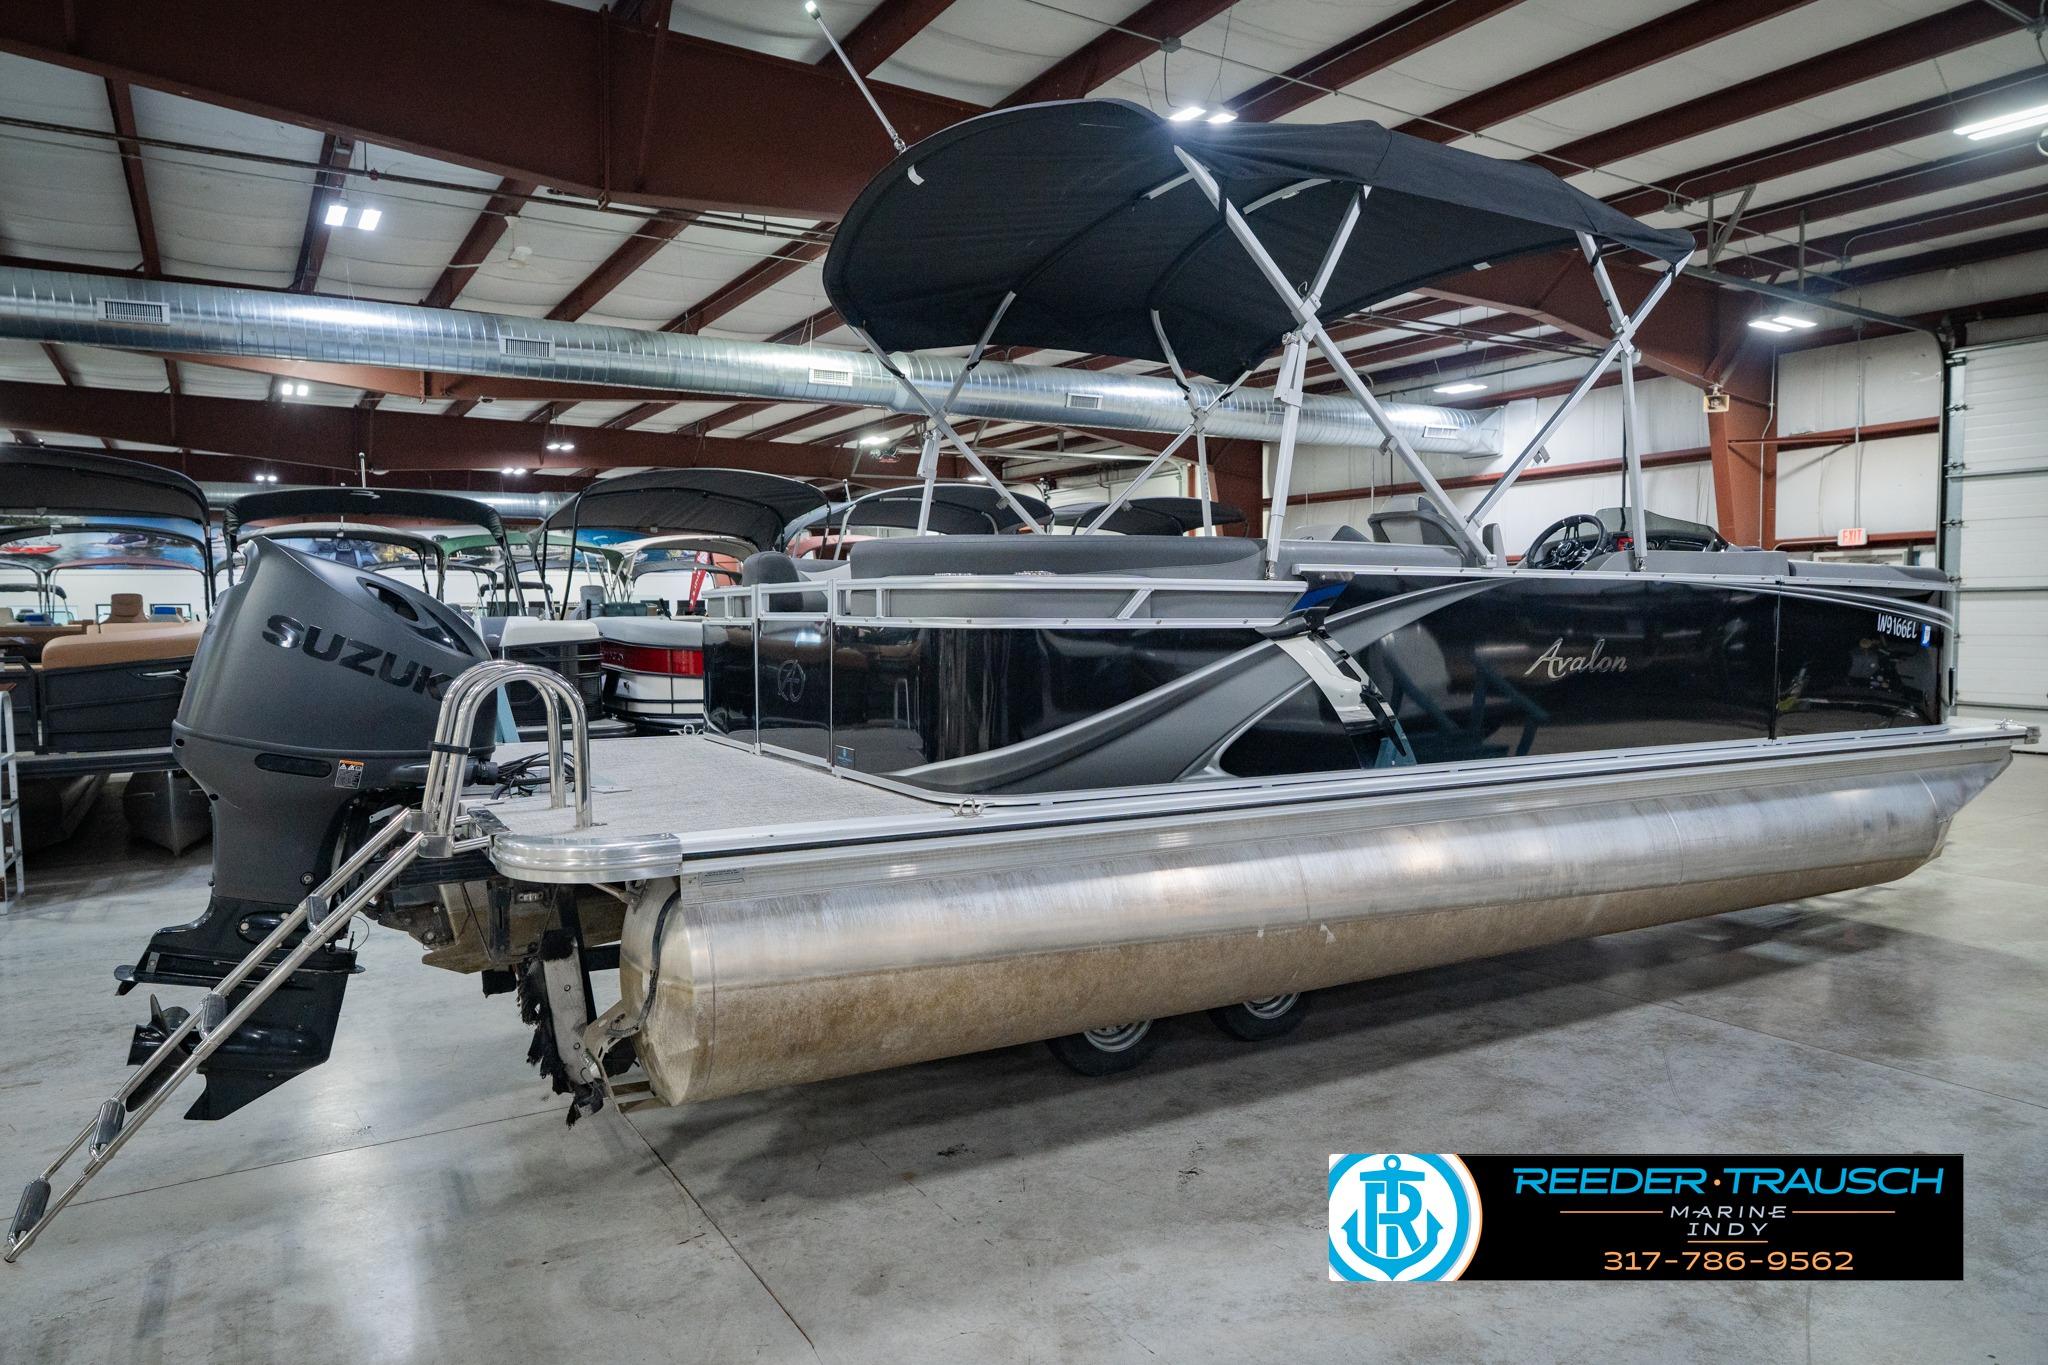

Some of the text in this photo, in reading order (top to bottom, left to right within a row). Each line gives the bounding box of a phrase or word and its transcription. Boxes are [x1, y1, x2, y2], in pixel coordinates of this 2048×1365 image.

[1842, 529, 1863, 544] EXIT
[262, 614, 453, 702] SUZUK
[1523, 637, 1627, 680] Avalon
